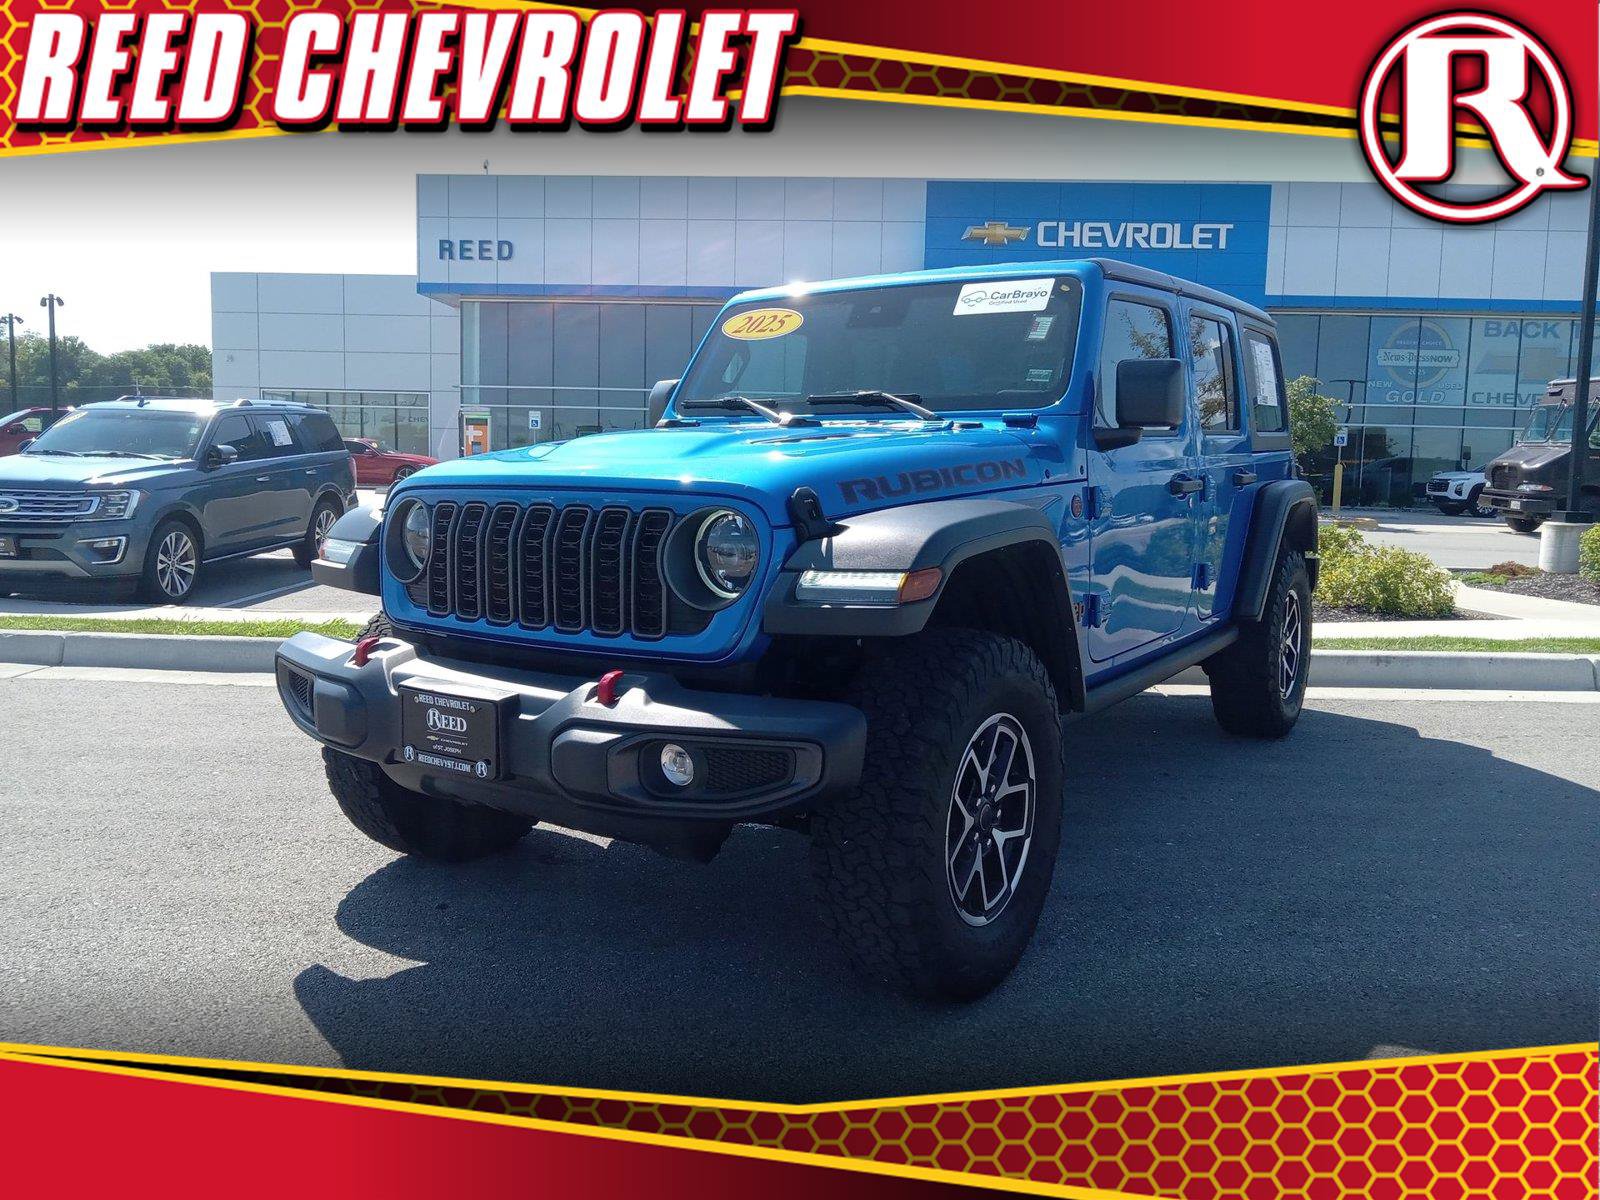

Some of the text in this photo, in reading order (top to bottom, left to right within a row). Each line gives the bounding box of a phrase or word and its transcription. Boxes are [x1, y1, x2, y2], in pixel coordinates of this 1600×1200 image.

[1036, 221, 1234, 249] CHEVROLET
[438, 239, 514, 261] REED
[731, 314, 793, 335] 2025
[1483, 320, 1560, 339] BACK
[1367, 380, 1392, 388] NEW
[1386, 390, 1446, 403] GOLD
[835, 457, 1027, 505] RUBICON
[418, 693, 470, 711] REED CHEVROLET
[427, 708, 467, 732] REED
